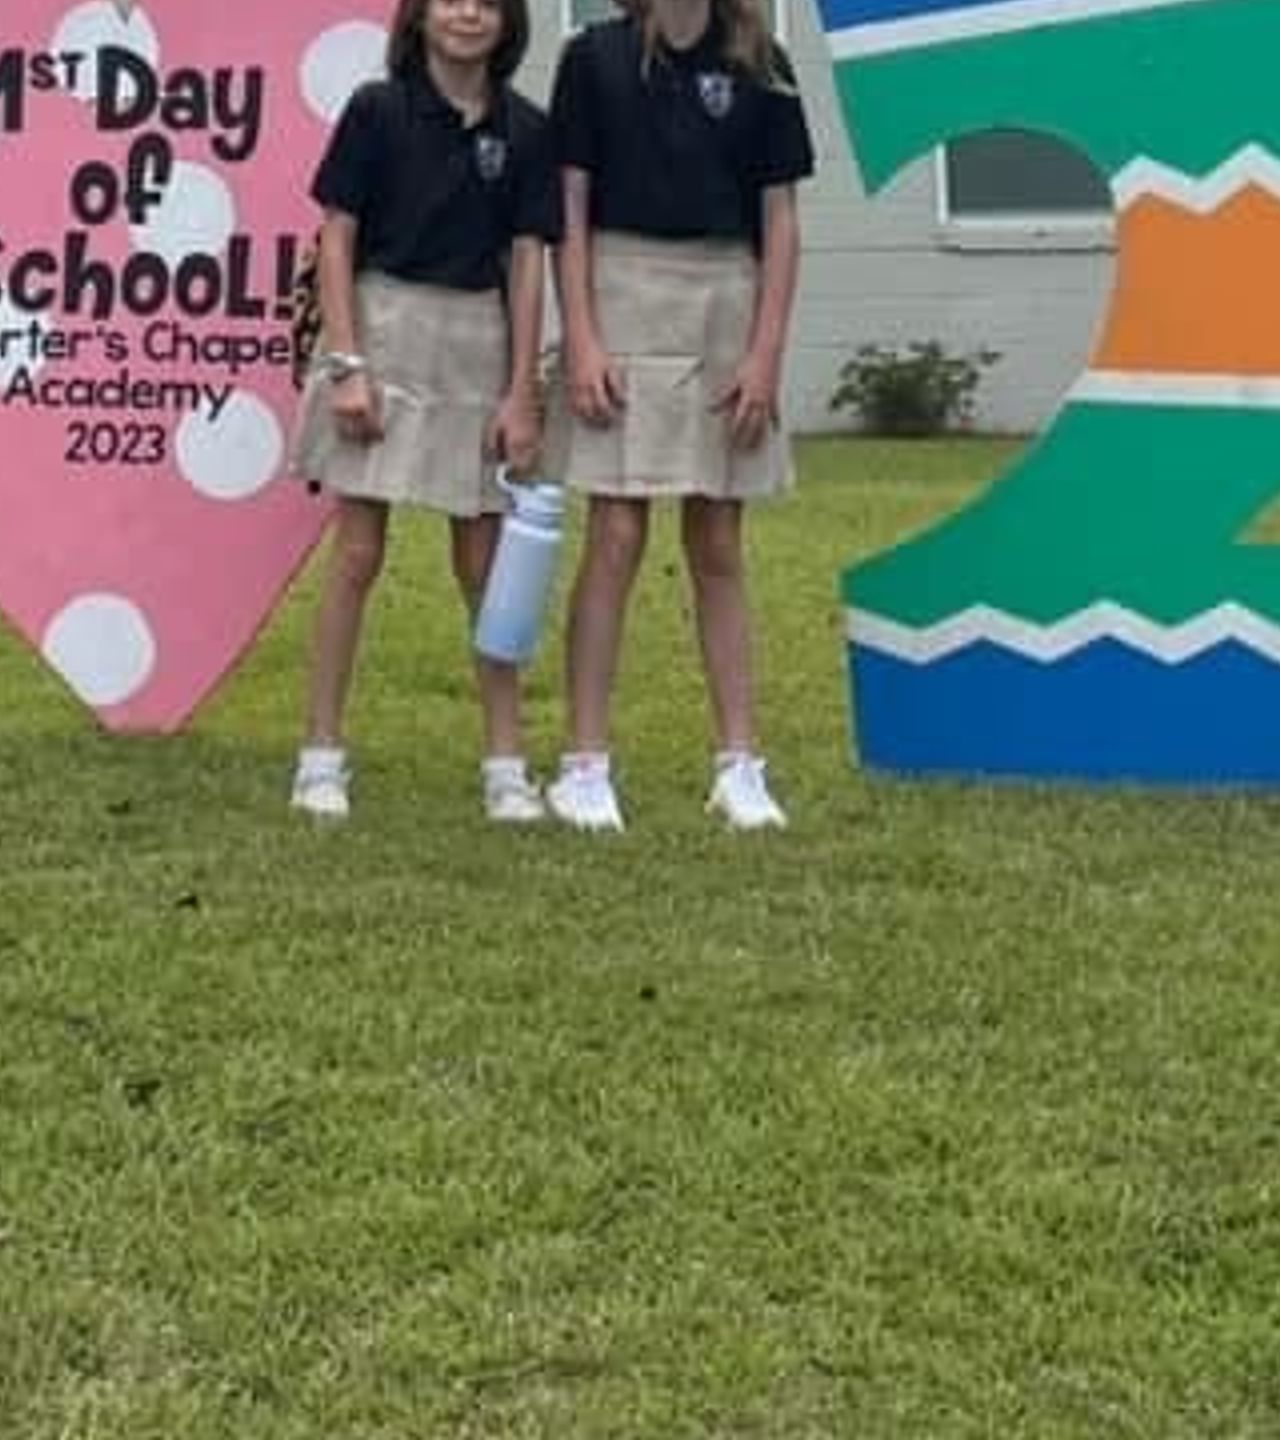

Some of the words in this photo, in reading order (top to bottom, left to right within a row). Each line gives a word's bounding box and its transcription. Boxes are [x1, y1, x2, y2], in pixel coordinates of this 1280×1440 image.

[96, 44, 265, 162] Day
[70, 132, 175, 226] of
[1, 367, 237, 421] Academy
[64, 422, 167, 466] 2023
